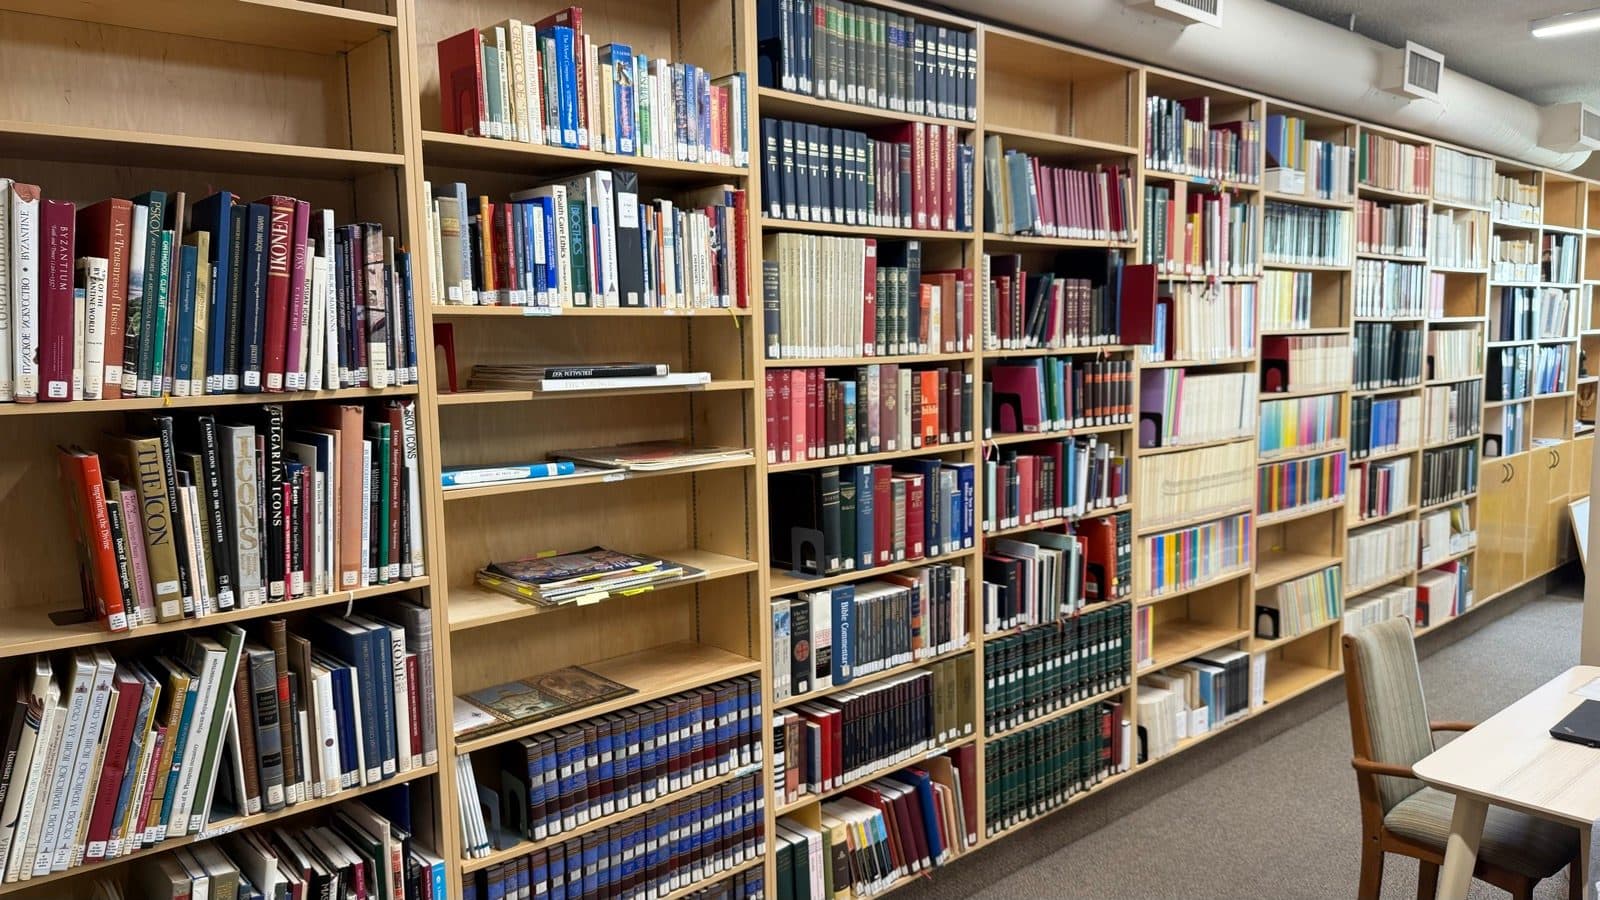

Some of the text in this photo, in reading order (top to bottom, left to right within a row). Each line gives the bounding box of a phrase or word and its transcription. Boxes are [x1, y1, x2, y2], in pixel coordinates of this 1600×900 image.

[147, 200, 162, 237] PSKOV
[556, 190, 564, 214] Health
[20, 211, 29, 260] BYZANTINE
[270, 211, 288, 270] IKONEN
[559, 235, 567, 257] Ethics
[570, 207, 583, 254] BIOETHICS
[59, 225, 68, 290] BYZANTIUM
[148, 246, 156, 271] TREASURES
[160, 240, 168, 275] ORTHODOX
[294, 243, 304, 269] ICONS
[97, 283, 104, 293] OF
[110, 219, 125, 335] Art Treasures of Russia
[21, 278, 30, 328] ИСКУССТВО
[205, 423, 213, 447] FAMOUS
[403, 408, 416, 459] SKOV ICONS
[161, 429, 178, 513] ICONS WINDOWS TO ETERNITY
[270, 408, 281, 526] BULGARIAN ICONS
[135, 444, 168, 546] THE ICON
[212, 489, 218, 497] TO
[235, 435, 258, 550] ICONS
[92, 483, 111, 550] Imprinting the Divine
[214, 510, 223, 542] CENTURIES
[115, 537, 125, 553] Doors
[119, 561, 131, 589] Perception
[840, 601, 848, 667] Bible Commentary
[392, 639, 402, 680] ROME
[170, 686, 184, 726] TALES OF GLORY
[2, 749, 16, 780] Russian
